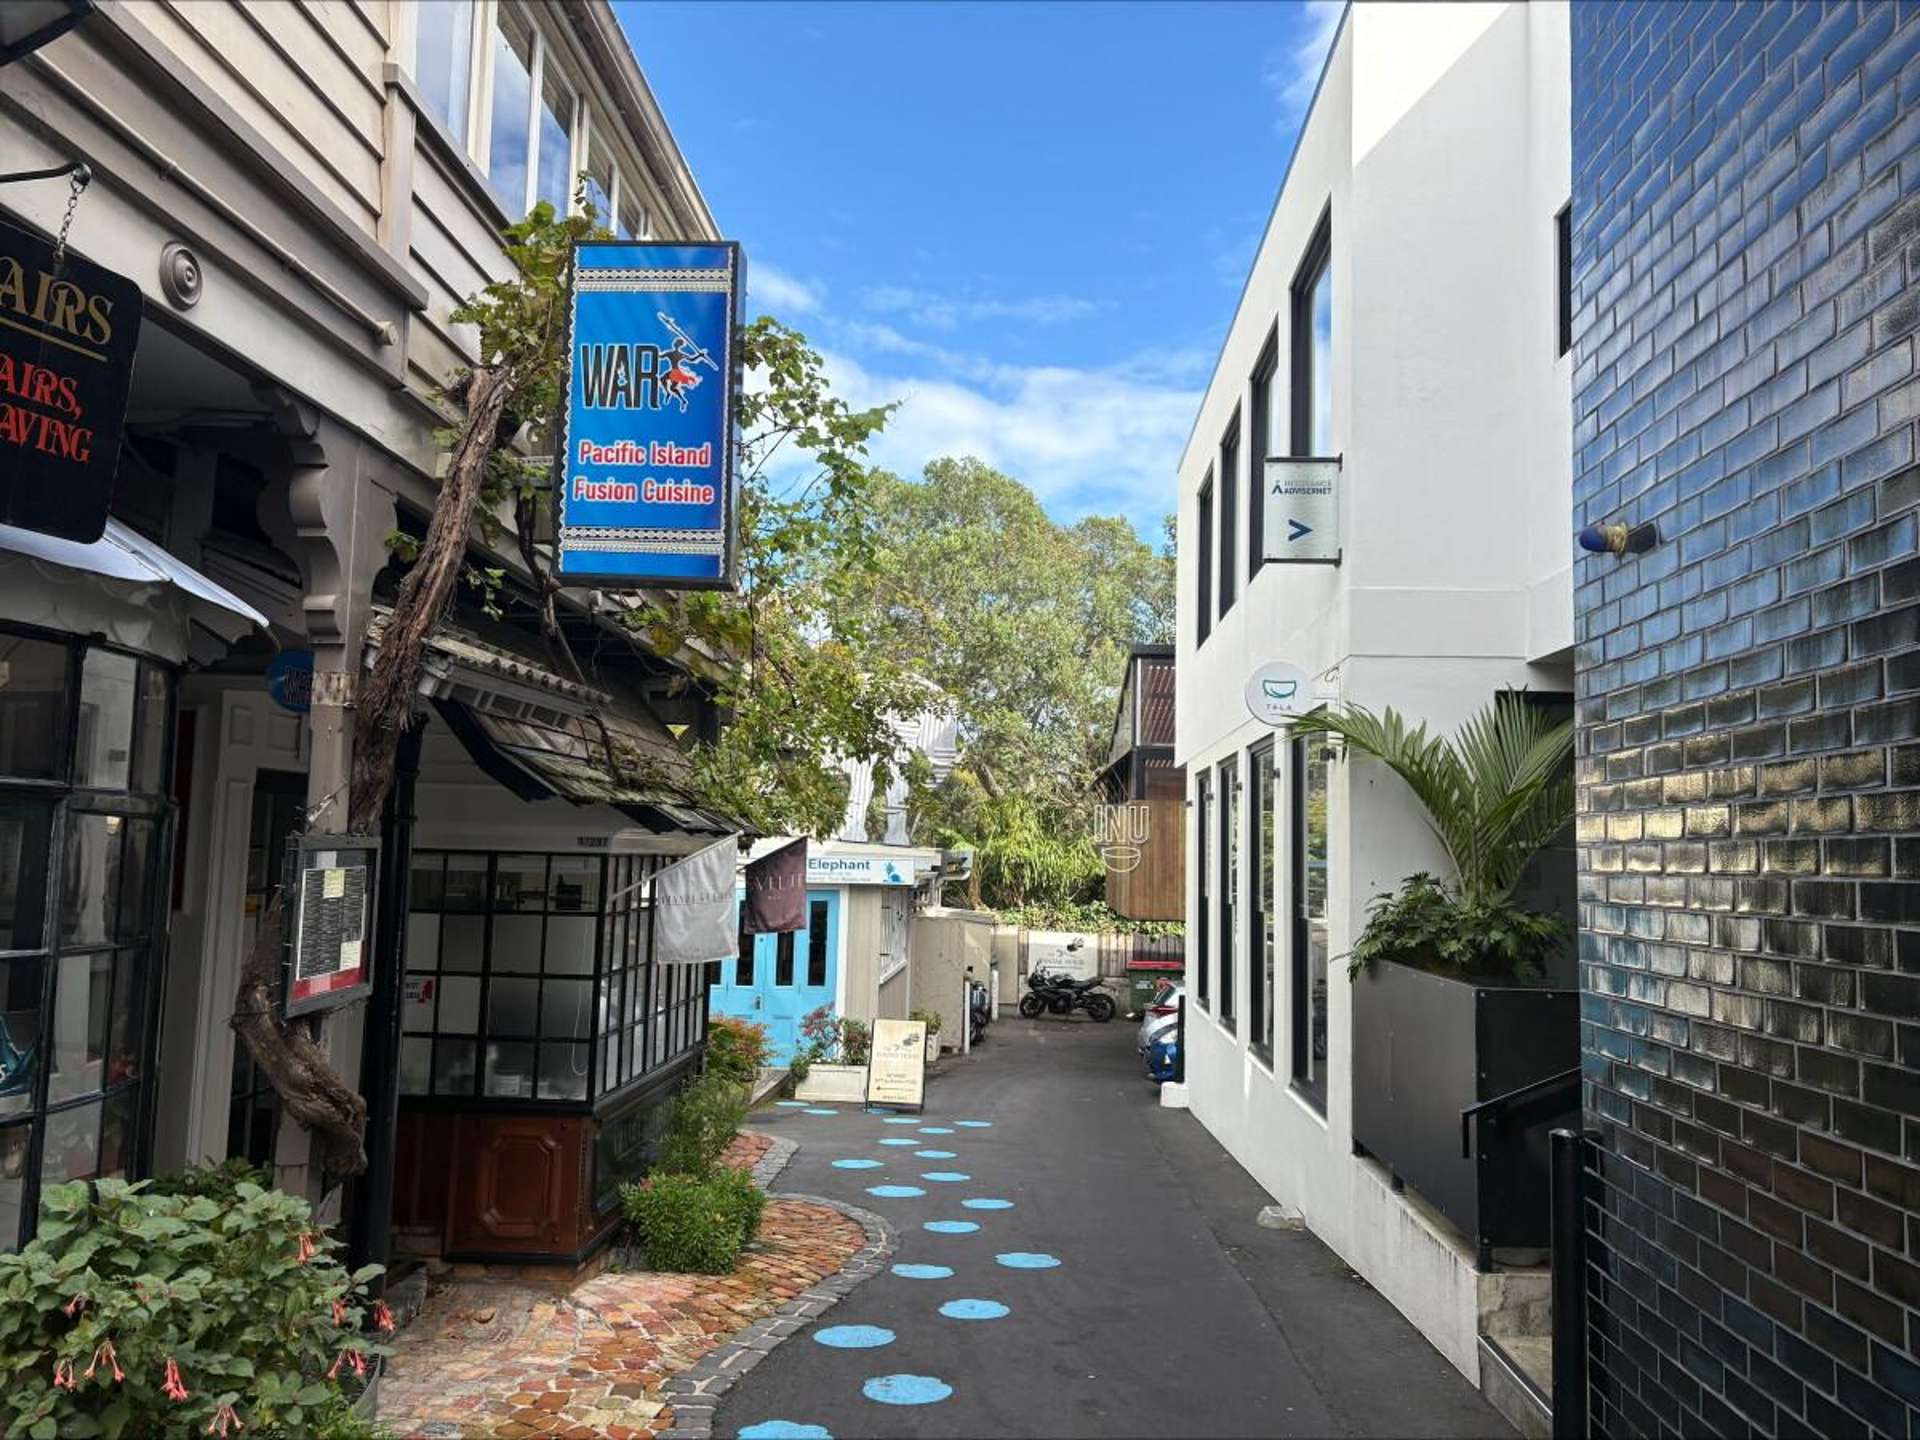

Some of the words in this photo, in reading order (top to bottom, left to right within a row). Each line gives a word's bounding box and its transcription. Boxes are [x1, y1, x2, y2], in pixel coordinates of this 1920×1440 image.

[579, 439, 646, 464] Pacific
[650, 440, 710, 467] Island
[573, 477, 638, 501] Fusion
[642, 478, 714, 503] Cuisine
[808, 858, 871, 872] Elephant
